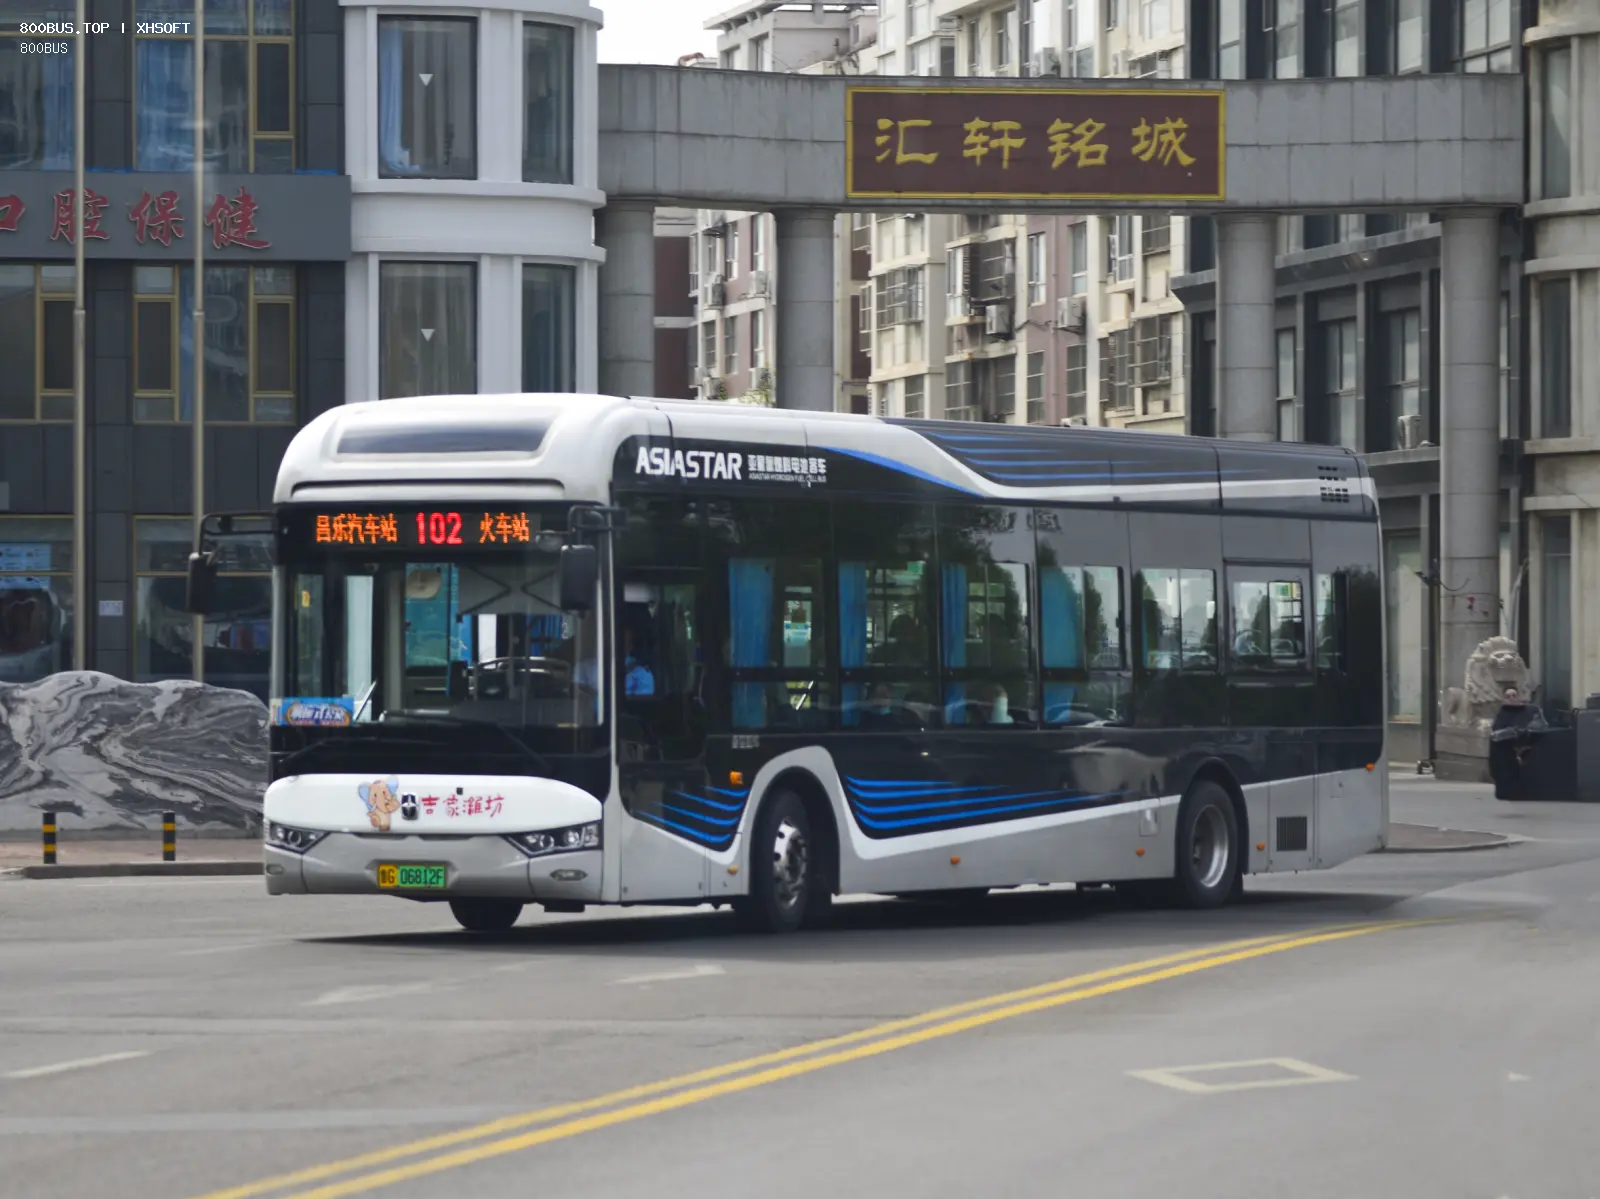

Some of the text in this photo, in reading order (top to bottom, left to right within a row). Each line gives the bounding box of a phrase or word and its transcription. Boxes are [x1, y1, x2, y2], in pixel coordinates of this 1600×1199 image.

[875, 116, 1196, 169] 汇轩铭城
[0, 186, 271, 250] 口腔保健
[635, 446, 742, 480] ASIASTAR
[316, 512, 530, 544] 昌乐汽车站 102 火车站
[400, 868, 444, 885] 06812F
